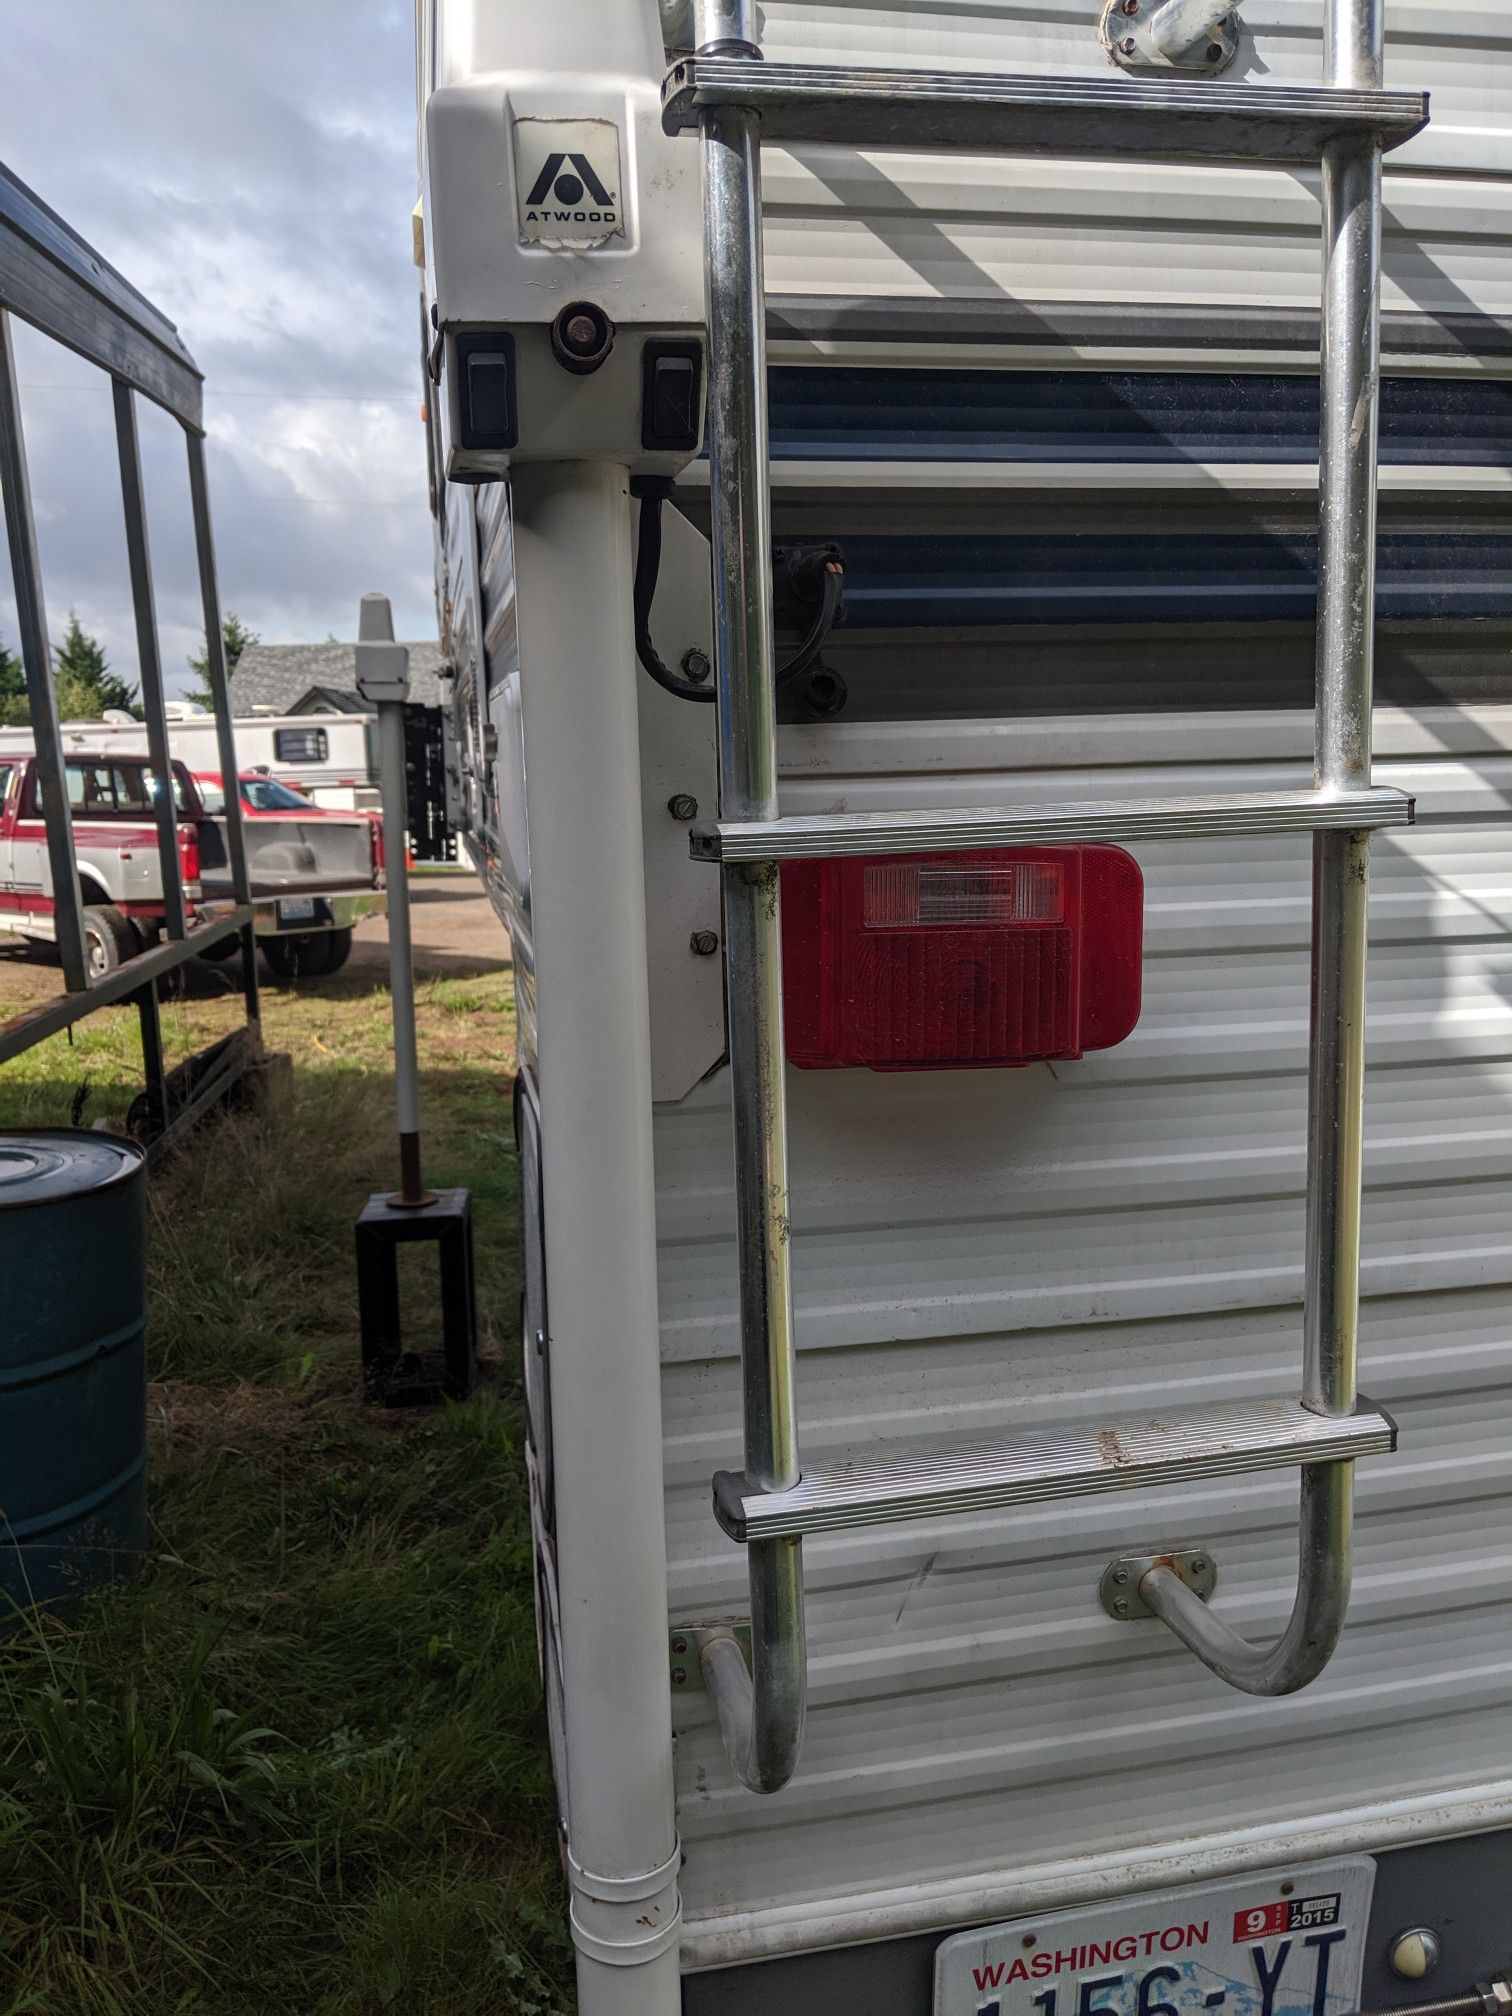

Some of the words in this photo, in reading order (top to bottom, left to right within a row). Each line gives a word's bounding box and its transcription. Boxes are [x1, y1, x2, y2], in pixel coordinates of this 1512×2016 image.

[526, 211, 616, 222] ATWOOD
[1247, 1910, 1266, 1933] 9
[1290, 1908, 1335, 1928] 2015
[972, 1921, 1210, 1992] WASHINGTON
